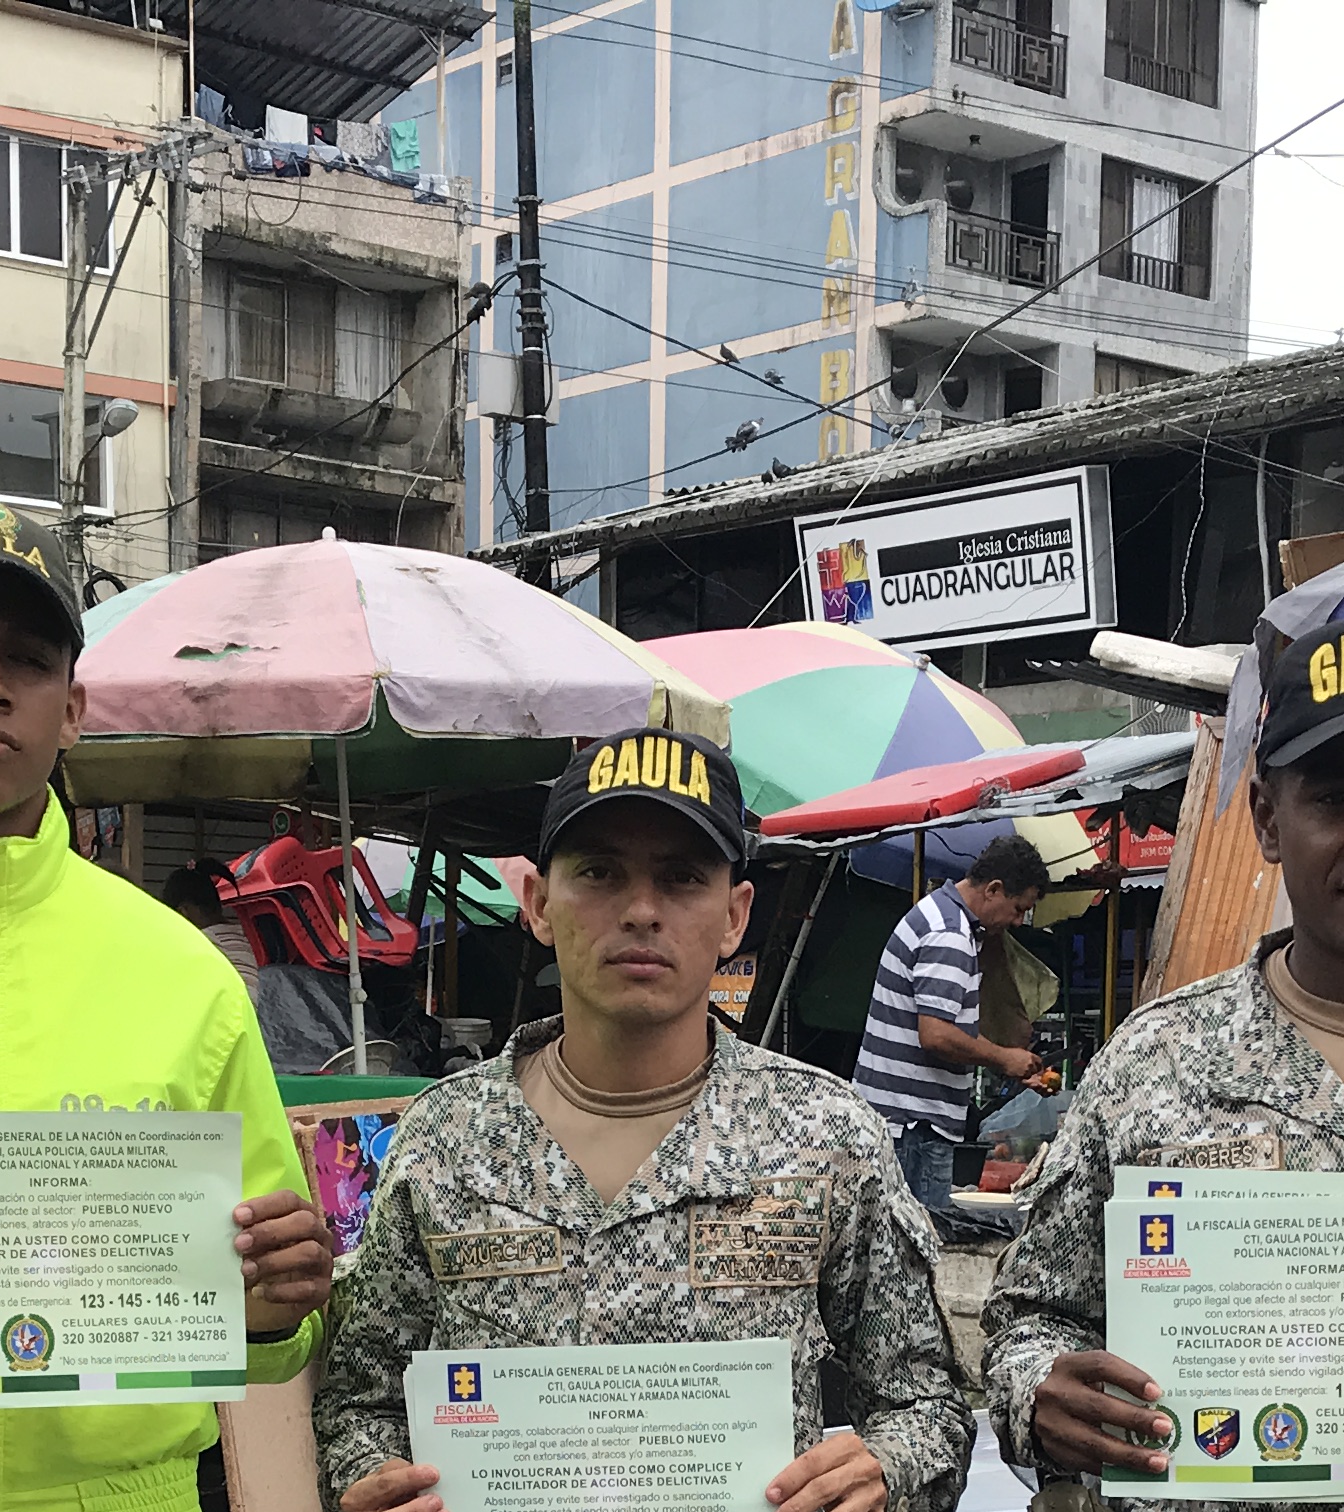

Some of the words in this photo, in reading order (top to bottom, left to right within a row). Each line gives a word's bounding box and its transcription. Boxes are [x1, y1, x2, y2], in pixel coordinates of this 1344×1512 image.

[958, 538, 1002, 564] Iglesia
[1006, 527, 1071, 552] Cristiana
[880, 552, 1075, 606] CUADRANGULAR
[587, 729, 711, 806] GAULA
[29, 1177, 92, 1187] INFORMA:
[82, 1204, 129, 1214] PUEBLO
[132, 1204, 172, 1214] NUEVO
[13, 1236, 22, 1246] A
[25, 1235, 67, 1246] USTED
[71, 1235, 110, 1245] COMO
[113, 1233, 179, 1244] COMPLICE
[182, 1233, 190, 1243] Y
[10, 1249, 27, 1259] DE
[30, 1248, 96, 1259] ACCIONES
[101, 1246, 174, 1258] DELICTIVAS
[460, 1242, 538, 1264] MURCIA
[714, 1259, 803, 1279] ARMADA
[1125, 1257, 1189, 1270] FISCALIA
[80, 1294, 104, 1308] 123
[117, 1293, 142, 1308] 145
[155, 1292, 180, 1307] 146
[192, 1291, 217, 1306] 147
[1160, 1326, 1177, 1337] LO
[1181, 1324, 1266, 1336] INVOLUCRAN
[1269, 1324, 1278, 1334] A
[1281, 1323, 1324, 1334] USTED
[1177, 1338, 1262, 1349] FACILITADOR
[1266, 1337, 1283, 1348] DE
[436, 1403, 496, 1415] FISCALIA
[588, 1409, 648, 1420] INFORMA:
[639, 1435, 684, 1445] PUEBLO
[687, 1434, 726, 1444] NUEVO
[471, 1469, 488, 1479] LO
[491, 1467, 571, 1478] INVOLUCRAN
[573, 1466, 582, 1476] A
[584, 1465, 625, 1476] USTED
[628, 1464, 665, 1475] COMO
[669, 1462, 732, 1474] COMPLICE
[735, 1462, 743, 1472] Y
[487, 1479, 567, 1491] FACILITADOR
[571, 1479, 587, 1489] DE
[590, 1477, 653, 1488] ACCIONES
[656, 1475, 727, 1487] DELICTIVAS
